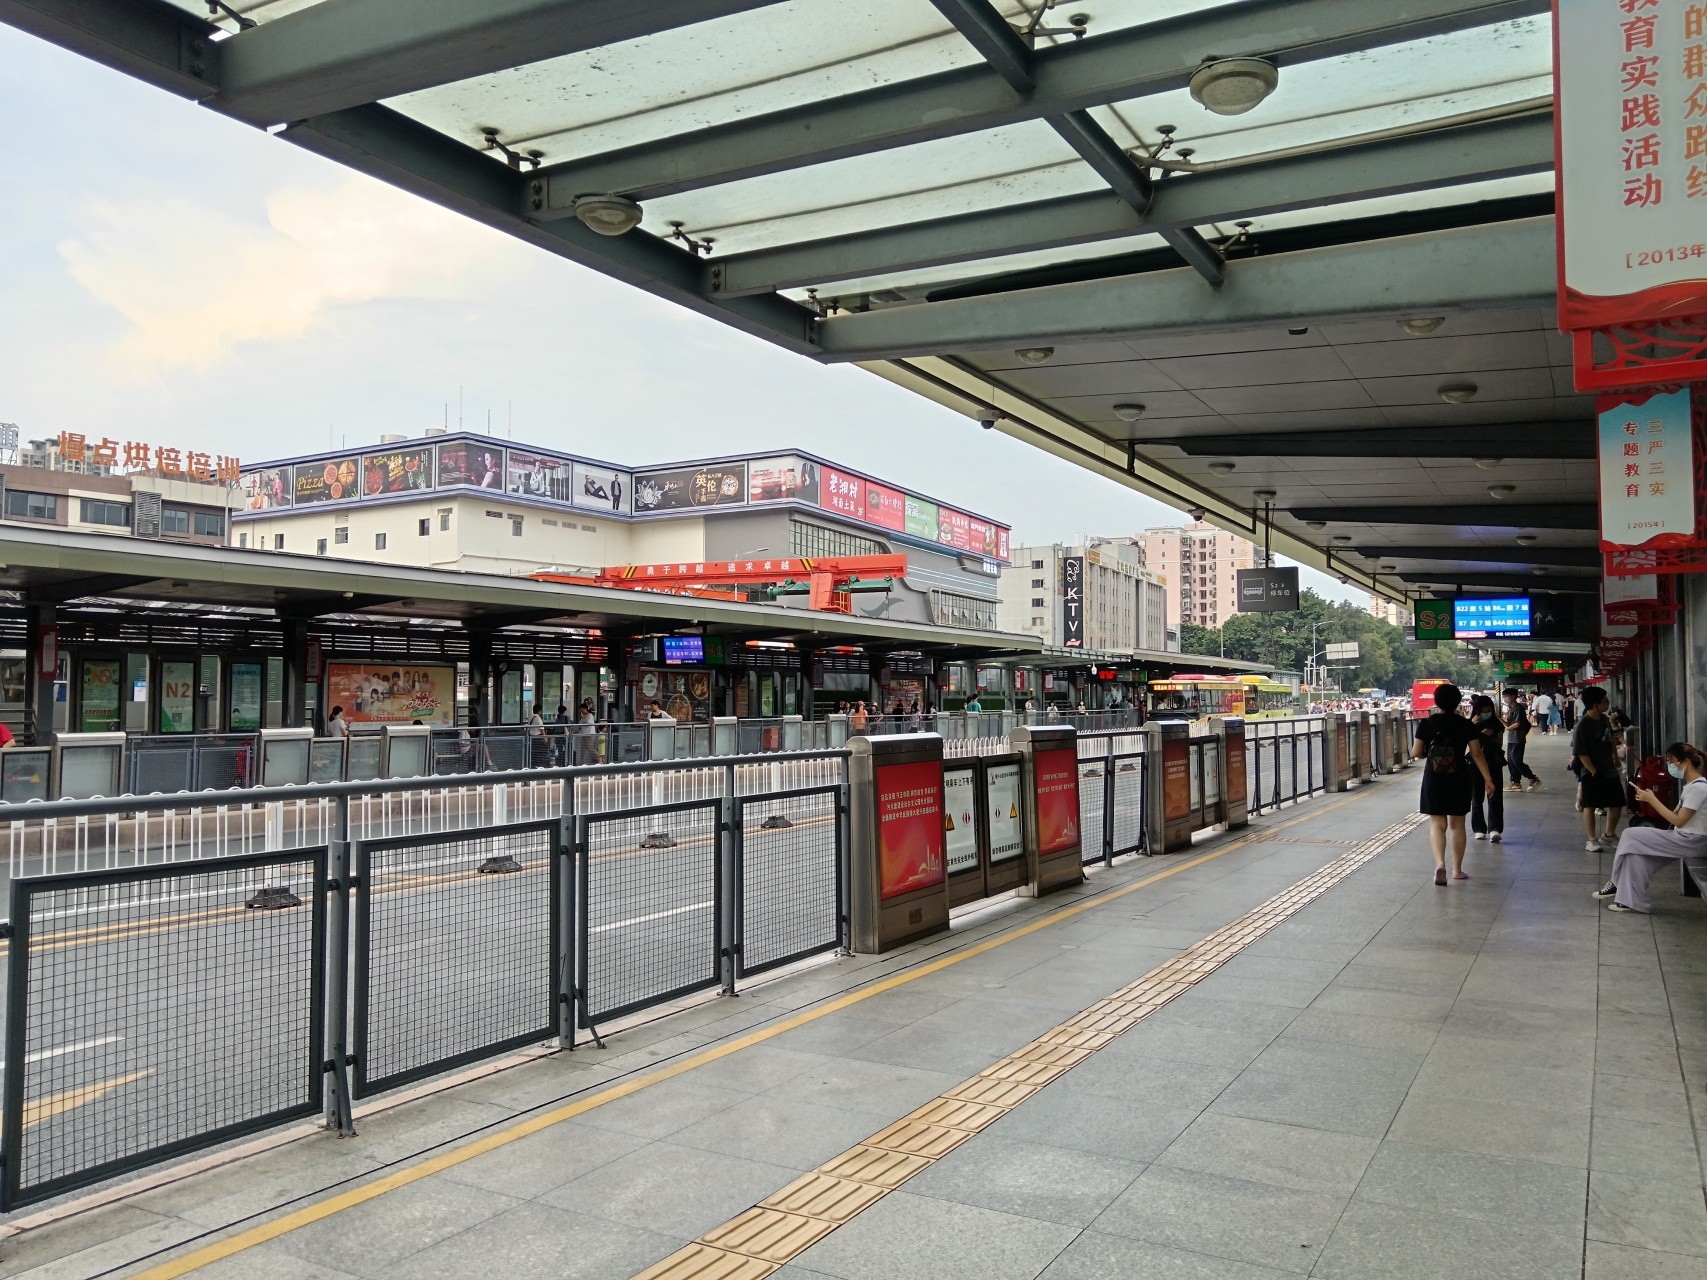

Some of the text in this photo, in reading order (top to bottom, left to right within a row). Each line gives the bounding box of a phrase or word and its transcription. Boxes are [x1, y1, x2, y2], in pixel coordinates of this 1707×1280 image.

[1622, 421, 1641, 498] 专题教育
[1647, 419, 1665, 496] 三严三实
[296, 476, 325, 490] Pizza
[646, 560, 790, 576] 勇于跨越 追求卓越
[1067, 587, 1079, 632] KTV
[1420, 610, 1450, 630] S2
[706, 643, 723, 658] N2
[1503, 661, 1521, 673] S3
[166, 682, 190, 698] N2
